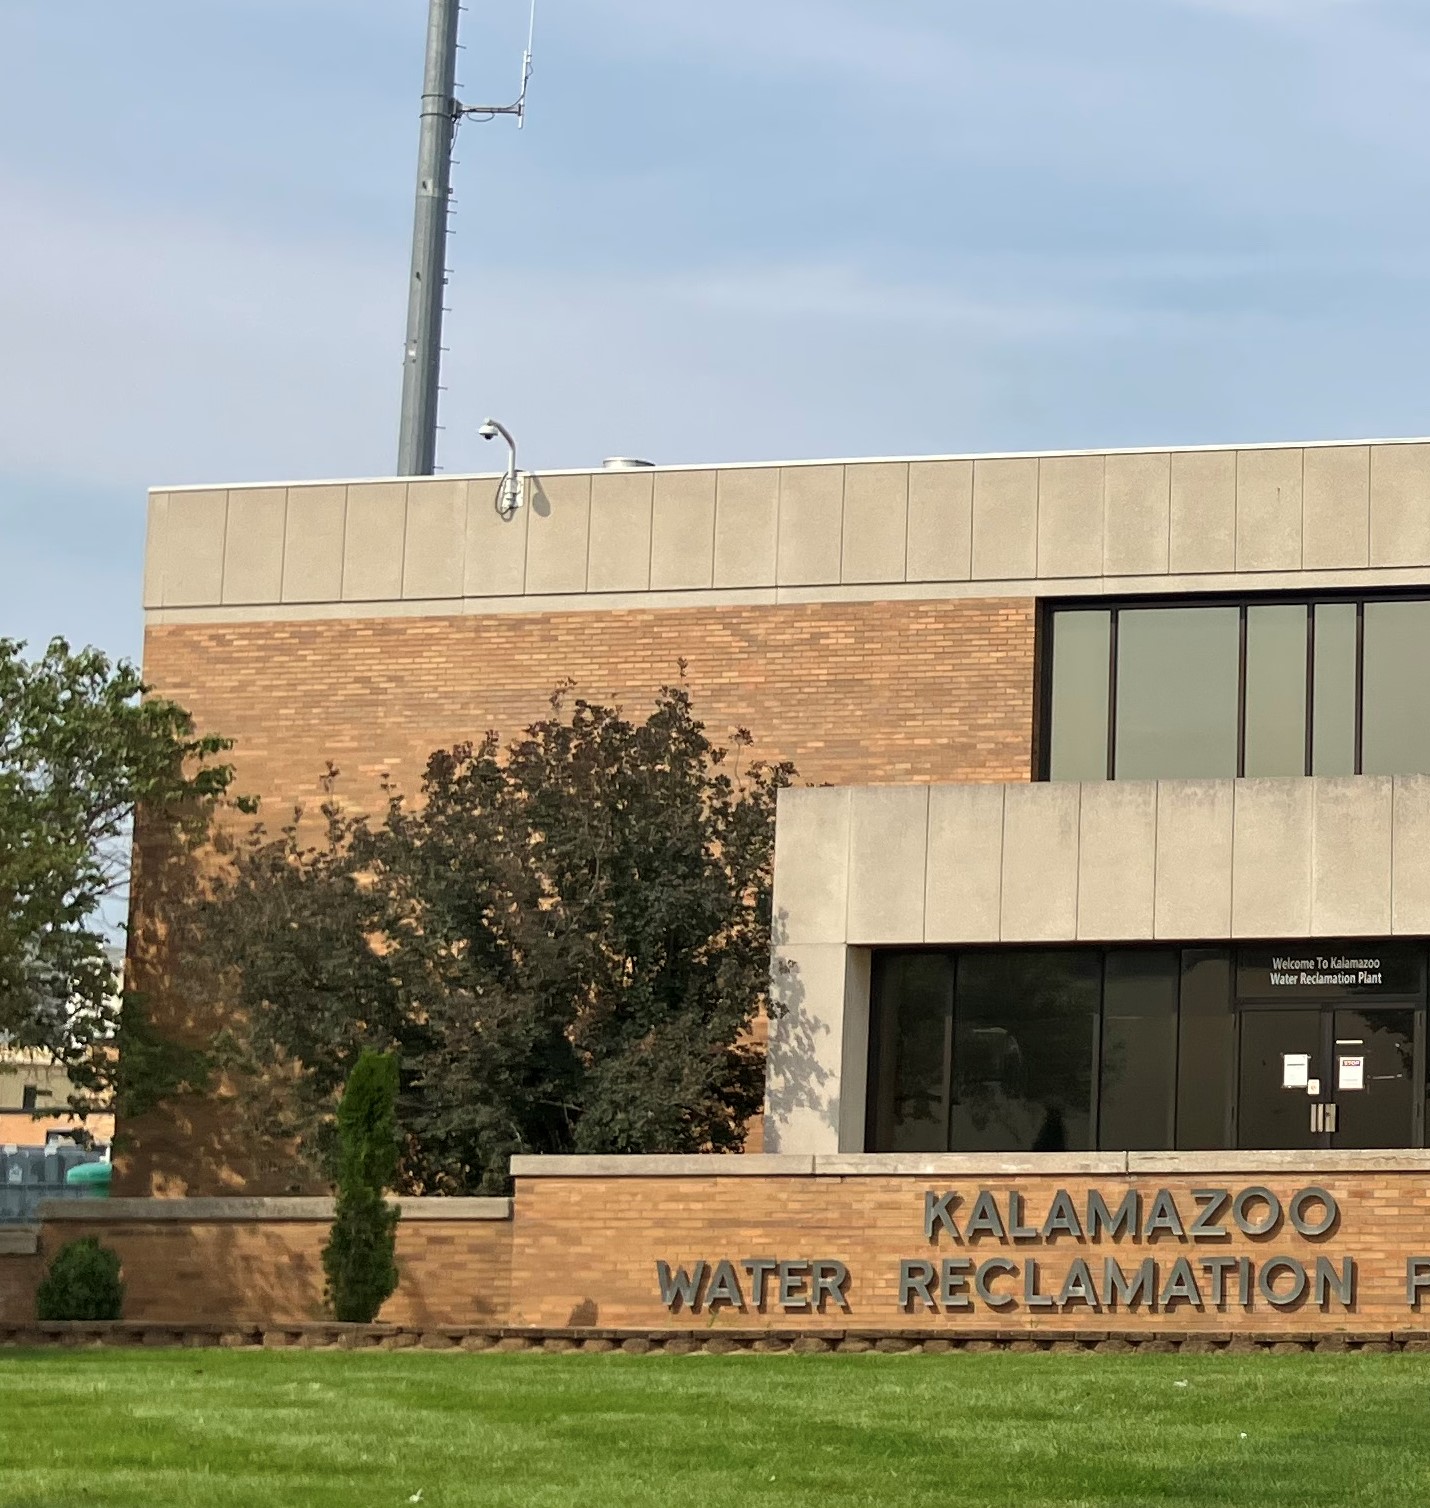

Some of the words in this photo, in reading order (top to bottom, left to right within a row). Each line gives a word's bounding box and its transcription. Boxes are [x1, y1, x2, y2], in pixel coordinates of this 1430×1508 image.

[1270, 972, 1298, 985] Water
[1300, 971, 1356, 984] Reclamation
[1358, 970, 1382, 984] Plant
[1272, 957, 1314, 970] Welcome
[1316, 957, 1328, 969] To
[1330, 956, 1380, 969] Kalamazoo
[924, 1186, 1338, 1238] KALAMAZOO
[656, 1258, 848, 1307] WATER
[899, 1255, 1354, 1307] RECLAMATION
